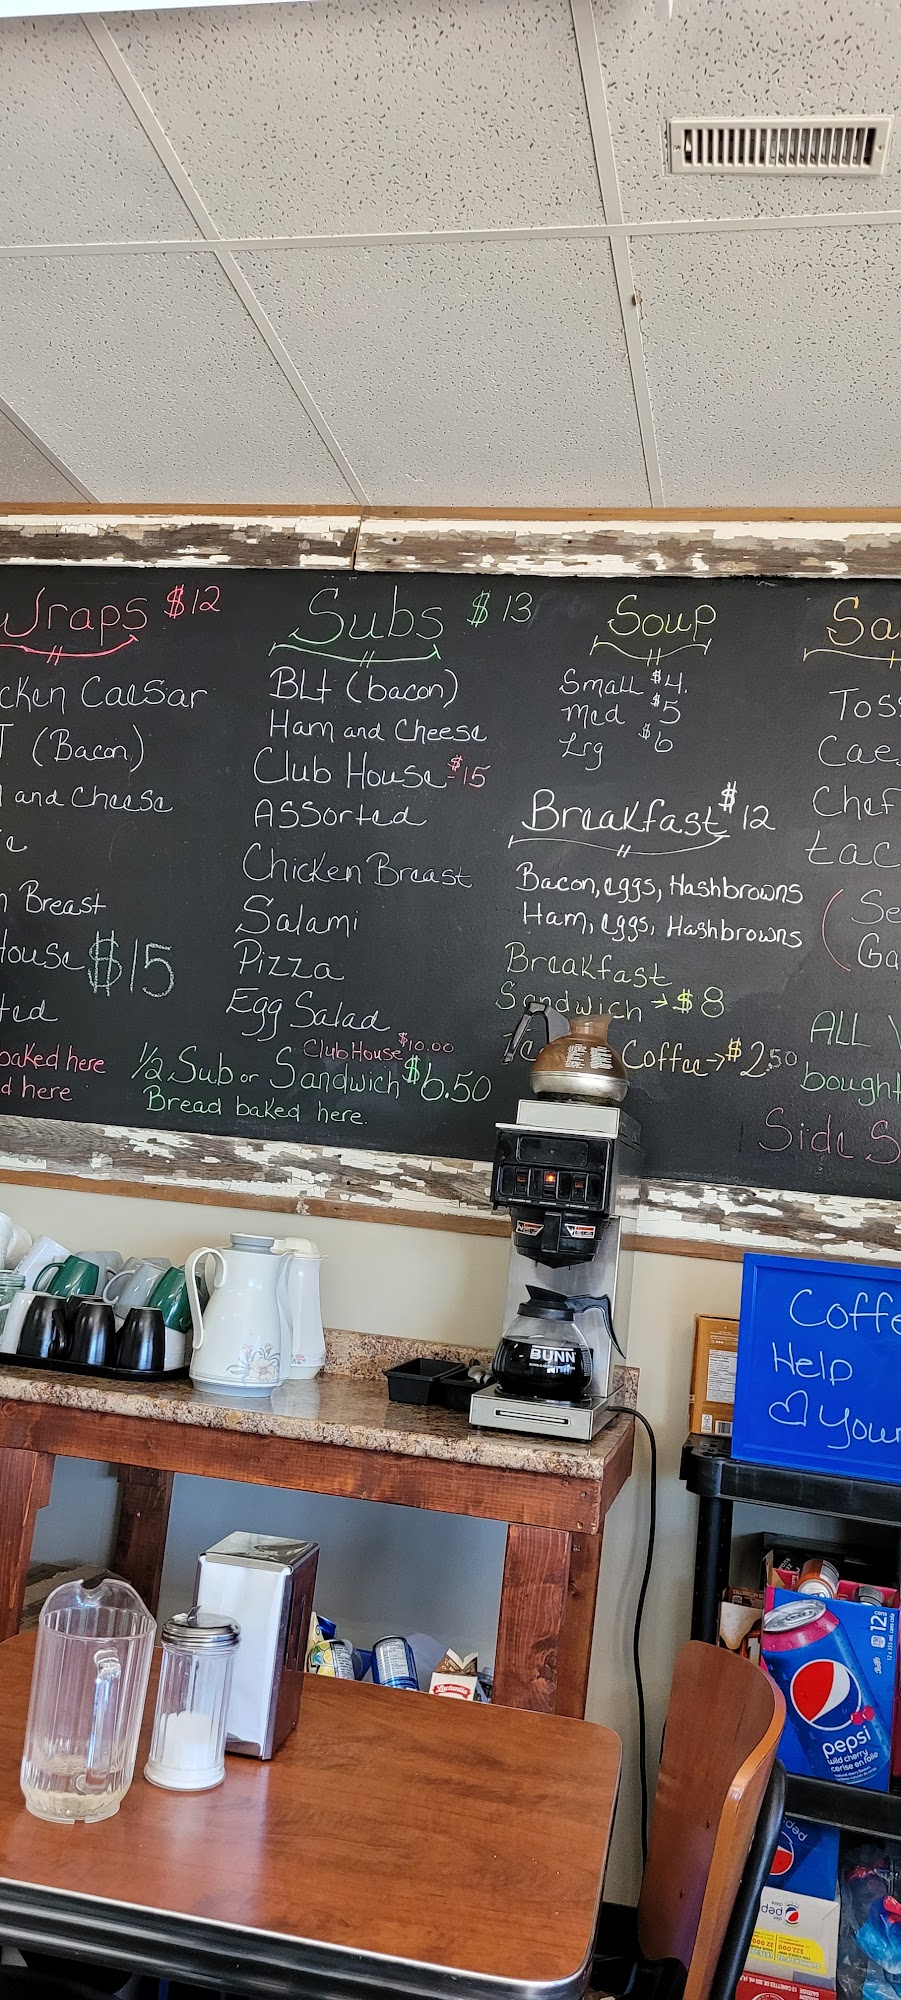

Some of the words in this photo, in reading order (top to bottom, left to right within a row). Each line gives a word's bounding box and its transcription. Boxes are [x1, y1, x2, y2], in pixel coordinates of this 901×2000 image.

[164, 584, 221, 619] $12
[289, 585, 444, 645] Subs
[607, 594, 717, 641] Soup
[346, 668, 459, 709] (bacon)
[558, 668, 644, 697] Small
[269, 708, 334, 743] Ham
[343, 723, 385, 740] and
[394, 718, 488, 744] Cheese
[560, 703, 625, 729] Med
[650, 693, 681, 725] $5
[32, 724, 144, 772] (Bacon)
[559, 732, 603, 771] Lrg
[638, 723, 673, 753] $6
[253, 747, 332, 784] Club
[346, 751, 447, 789] House
[14, 789, 64, 807] and
[71, 785, 174, 812] Cheese
[521, 788, 727, 836] Breakfast
[718, 780, 776, 830] $12
[242, 842, 362, 884] Chicken
[365, 851, 473, 888] Breast
[515, 861, 600, 898] Bacon,
[603, 876, 662, 903] eggs,
[670, 873, 803, 904] Hashbrowns
[18, 879, 106, 915] Breast
[235, 894, 359, 938] Salami
[522, 901, 593, 935] Ham,
[601, 912, 655, 942] eggs,
[666, 915, 803, 948] Hashbrowns
[88, 930, 175, 998] $15
[233, 938, 345, 981] Pizza
[504, 941, 673, 988] Breakfast
[225, 987, 283, 1041] Egg
[289, 990, 391, 1031] Salad
[810, 1010, 871, 1047] ALL
[66, 1045, 106, 1074] here
[397, 1031, 454, 1054] $10.00
[621, 1039, 709, 1077] Coffee
[21, 1075, 73, 1101] here
[166, 1045, 234, 1087] Sub
[239, 1072, 259, 1084] or
[269, 1045, 401, 1100] Sandwich
[401, 1054, 492, 1103] $6.50
[142, 1084, 221, 1116] Bread
[236, 1094, 300, 1123] baked
[758, 1107, 853, 1159] Side
[530, 1348, 576, 1363] BUNN
[772, 1341, 853, 1386] Help
[870, 1615, 888, 1631] 12
[822, 1725, 871, 1759] pepsi
[827, 1756, 843, 1765] wild
[844, 1749, 869, 1762] cherry
[831, 1764, 854, 1772] cerise
[864, 1751, 879, 1764] folie
[778, 1945, 804, 1955] $22,000
